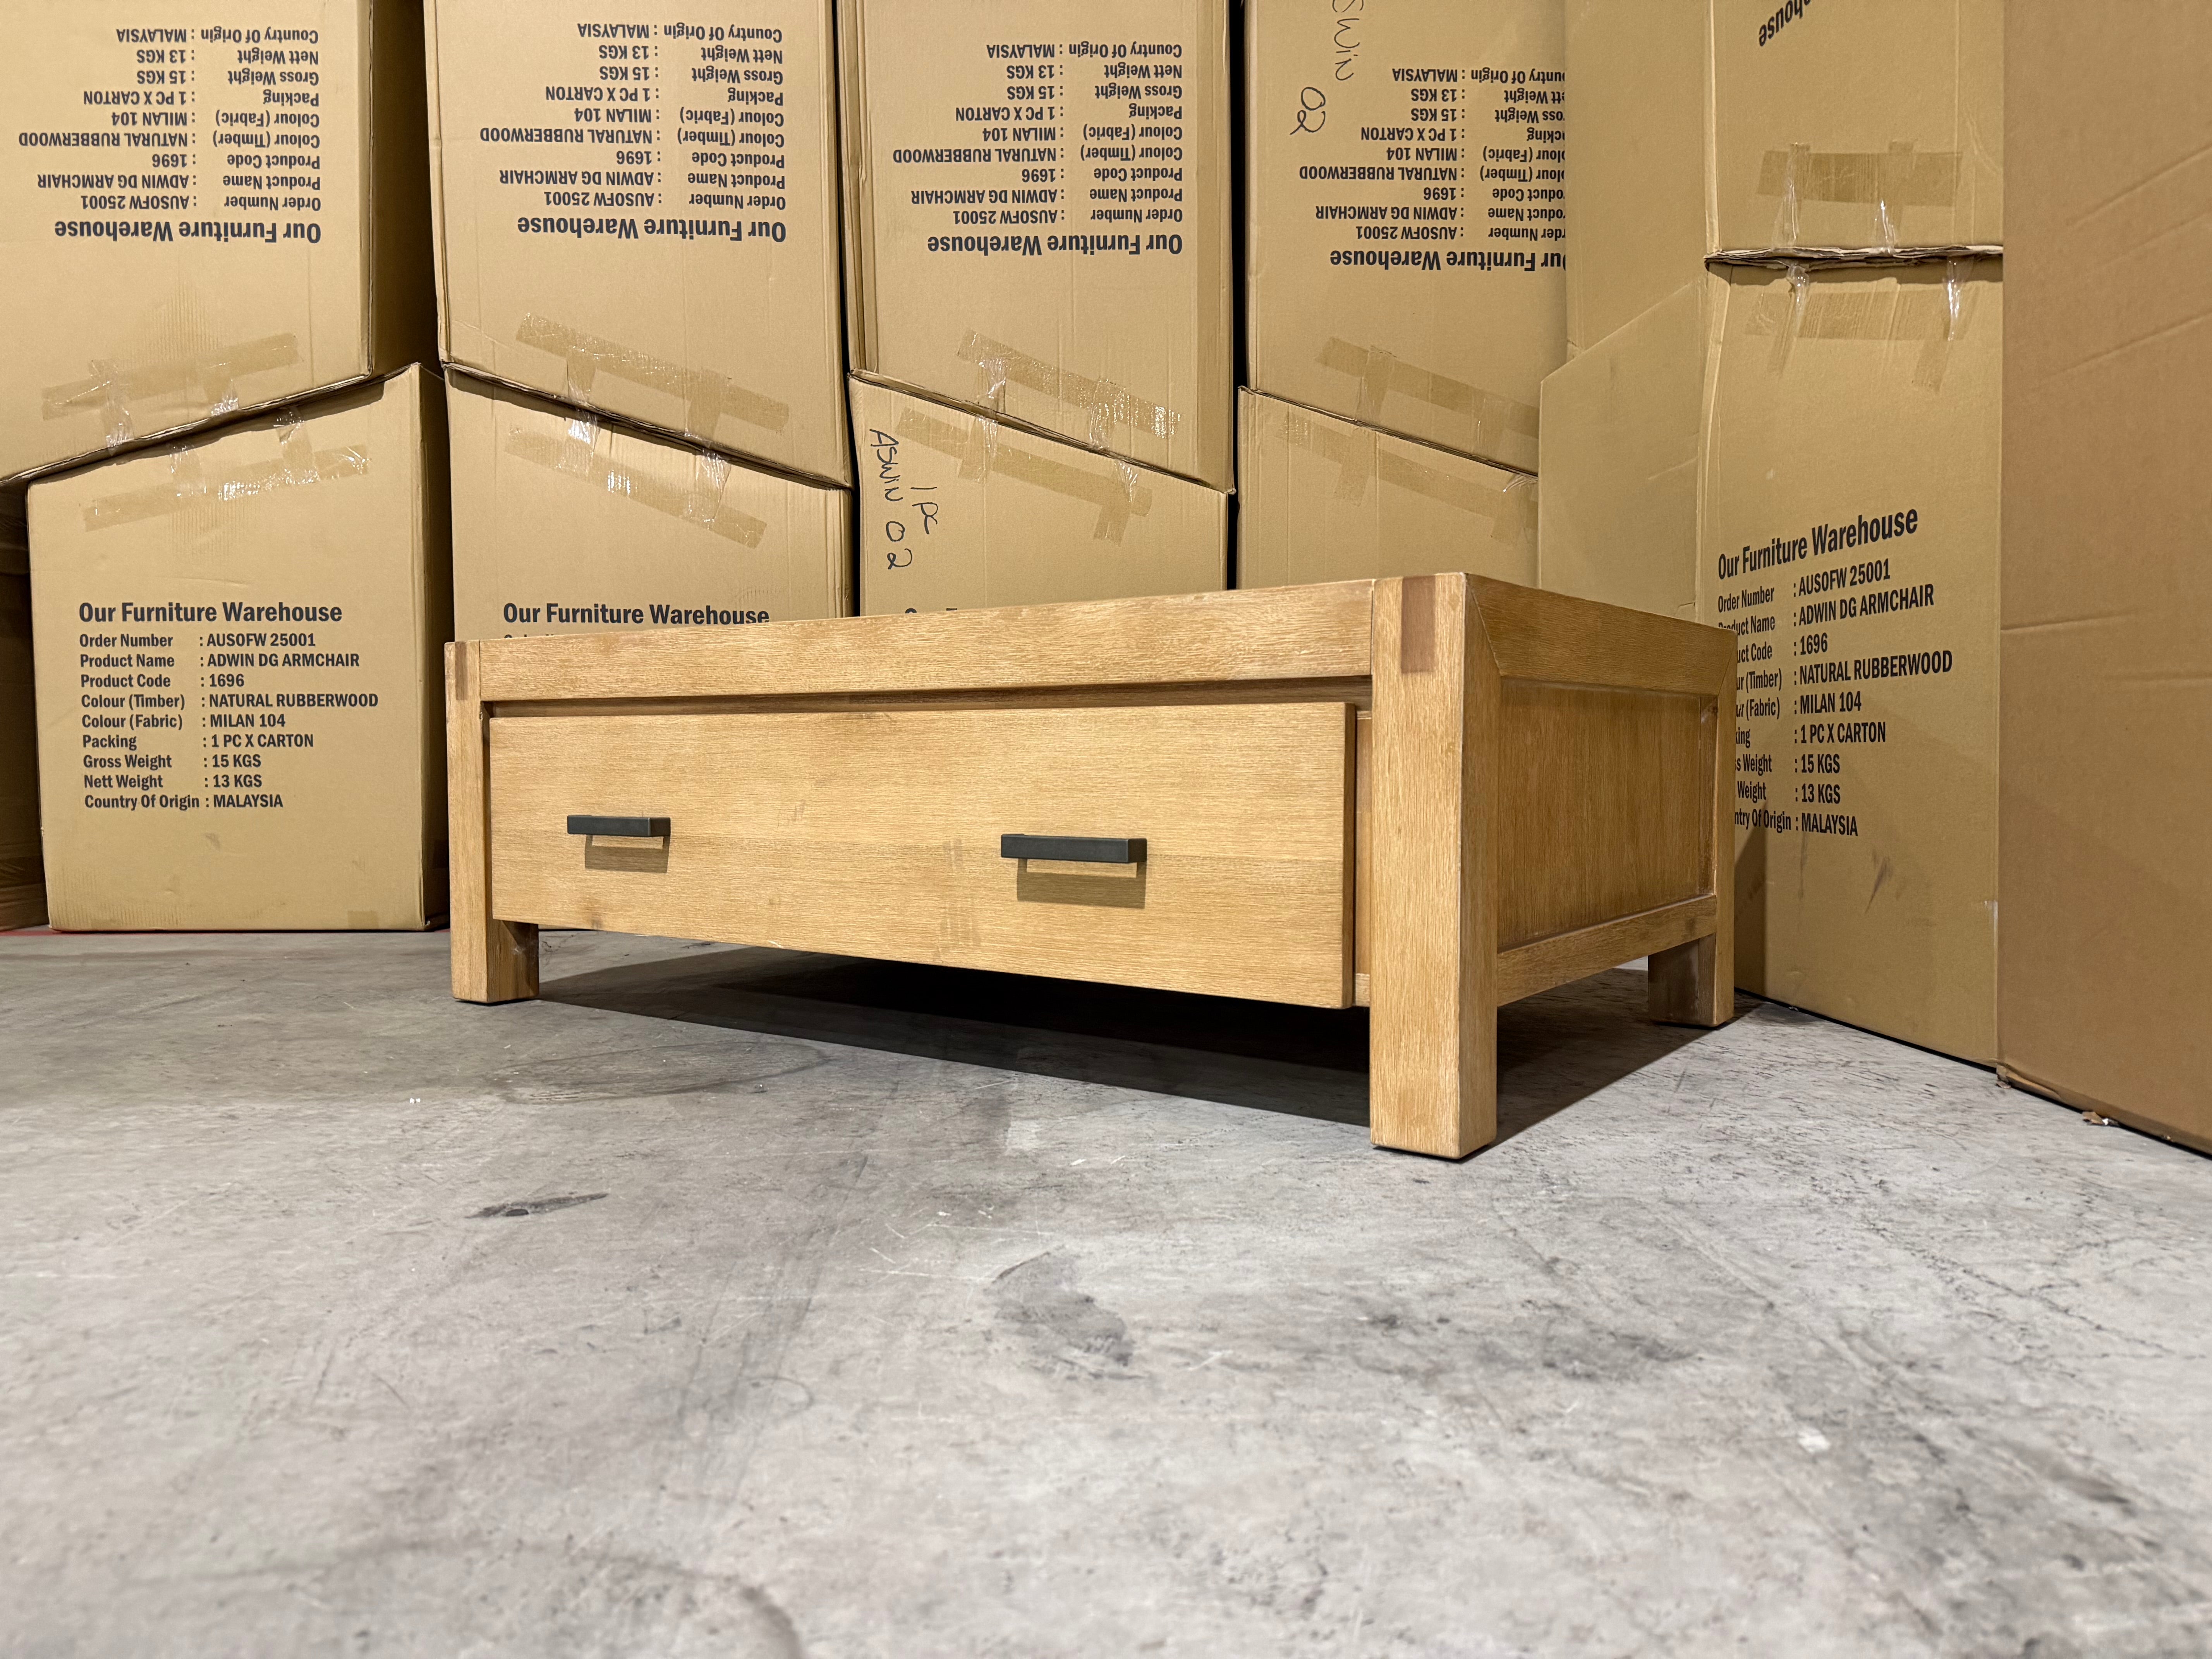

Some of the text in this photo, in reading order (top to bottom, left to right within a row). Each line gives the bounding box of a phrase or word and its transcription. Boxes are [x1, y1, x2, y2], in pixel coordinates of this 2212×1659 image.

[116, 26, 318, 44] Country Of Origin MALAYSIA
[599, 65, 783, 85] Gross Weight 15 KGS
[1006, 62, 1182, 79] Nett Weight 13 KGS
[1392, 67, 1565, 84] untry Of Origin MALAYSIA
[574, 106, 784, 127] Colour (Fabric) MILAN 104
[956, 103, 1182, 121] Packing 1 PC X CARTON
[480, 127, 785, 148] Colour (Timber) NATURAL RUBBERWOOD
[616, 151, 785, 169] Product Code 1696
[1386, 146, 1565, 163] lour (Fabric) MILAN 104
[37, 174, 320, 191] Product Name ADWIN DG ARMCHAIR
[81, 195, 321, 211] Order Number AUSOFW 25001
[953, 209, 1183, 225] Order Number AUSOFW 25001
[1315, 206, 1565, 222] oduct Name ADWIN DG ARMCHAIR
[55, 221, 321, 244] Our Furniture Warehouse
[517, 217, 786, 242] Our Furniture Warehouse
[927, 234, 1182, 256] Our Furniture Warehouse
[1330, 250, 1441, 270] Warehouse
[1446, 251, 1535, 271] Furniture
[1718, 509, 1918, 580] Our Furniture Warehouse
[1718, 558, 1891, 613] Order Number AUSOFW 25001
[79, 602, 342, 622] Our Furniture Warehouse
[503, 603, 769, 625] Our Furniture Warehouse
[1750, 615, 1775, 634] Name
[1799, 600, 1836, 626] ADWIN
[1840, 597, 1856, 619] DG
[1859, 584, 1934, 616] ARMCHAIR
[79, 633, 316, 647] Order Number AUSOFW 25001
[1751, 641, 1772, 662] Code
[1800, 632, 1828, 655] 1696
[80, 653, 360, 667] Product Name ADWIN DG ARMCHAIR
[81, 673, 244, 688] Product Code 1696
[1746, 668, 1782, 694] (Timber)
[1800, 661, 1851, 685] NATURAL
[1854, 650, 1953, 680] RUBBERWOOD
[81, 693, 378, 711] Colour (Timber) NATURAL RUBBERWOOD
[1746, 697, 1780, 721] (Fabric)
[1800, 692, 1835, 714] MILAN
[1839, 690, 1862, 712] 104
[82, 714, 286, 730] Colour (Fabric) MILAN 104
[82, 734, 313, 751] Packing 1 PC X CARTON
[1801, 721, 1886, 744] 1 PC X CARTON
[83, 754, 261, 771] Gross Weight 15 KGS
[1742, 754, 1772, 776] Weight
[1801, 754, 1814, 773] 15
[1817, 754, 1840, 774] KGS
[84, 774, 262, 791] Nett Weight 13 KGS
[1737, 780, 1841, 804] Weight 13 KGS
[84, 794, 283, 811] Country Of Origin MALAYSIA
[1735, 808, 1858, 836] ntry Of Origin MALAYSIA
